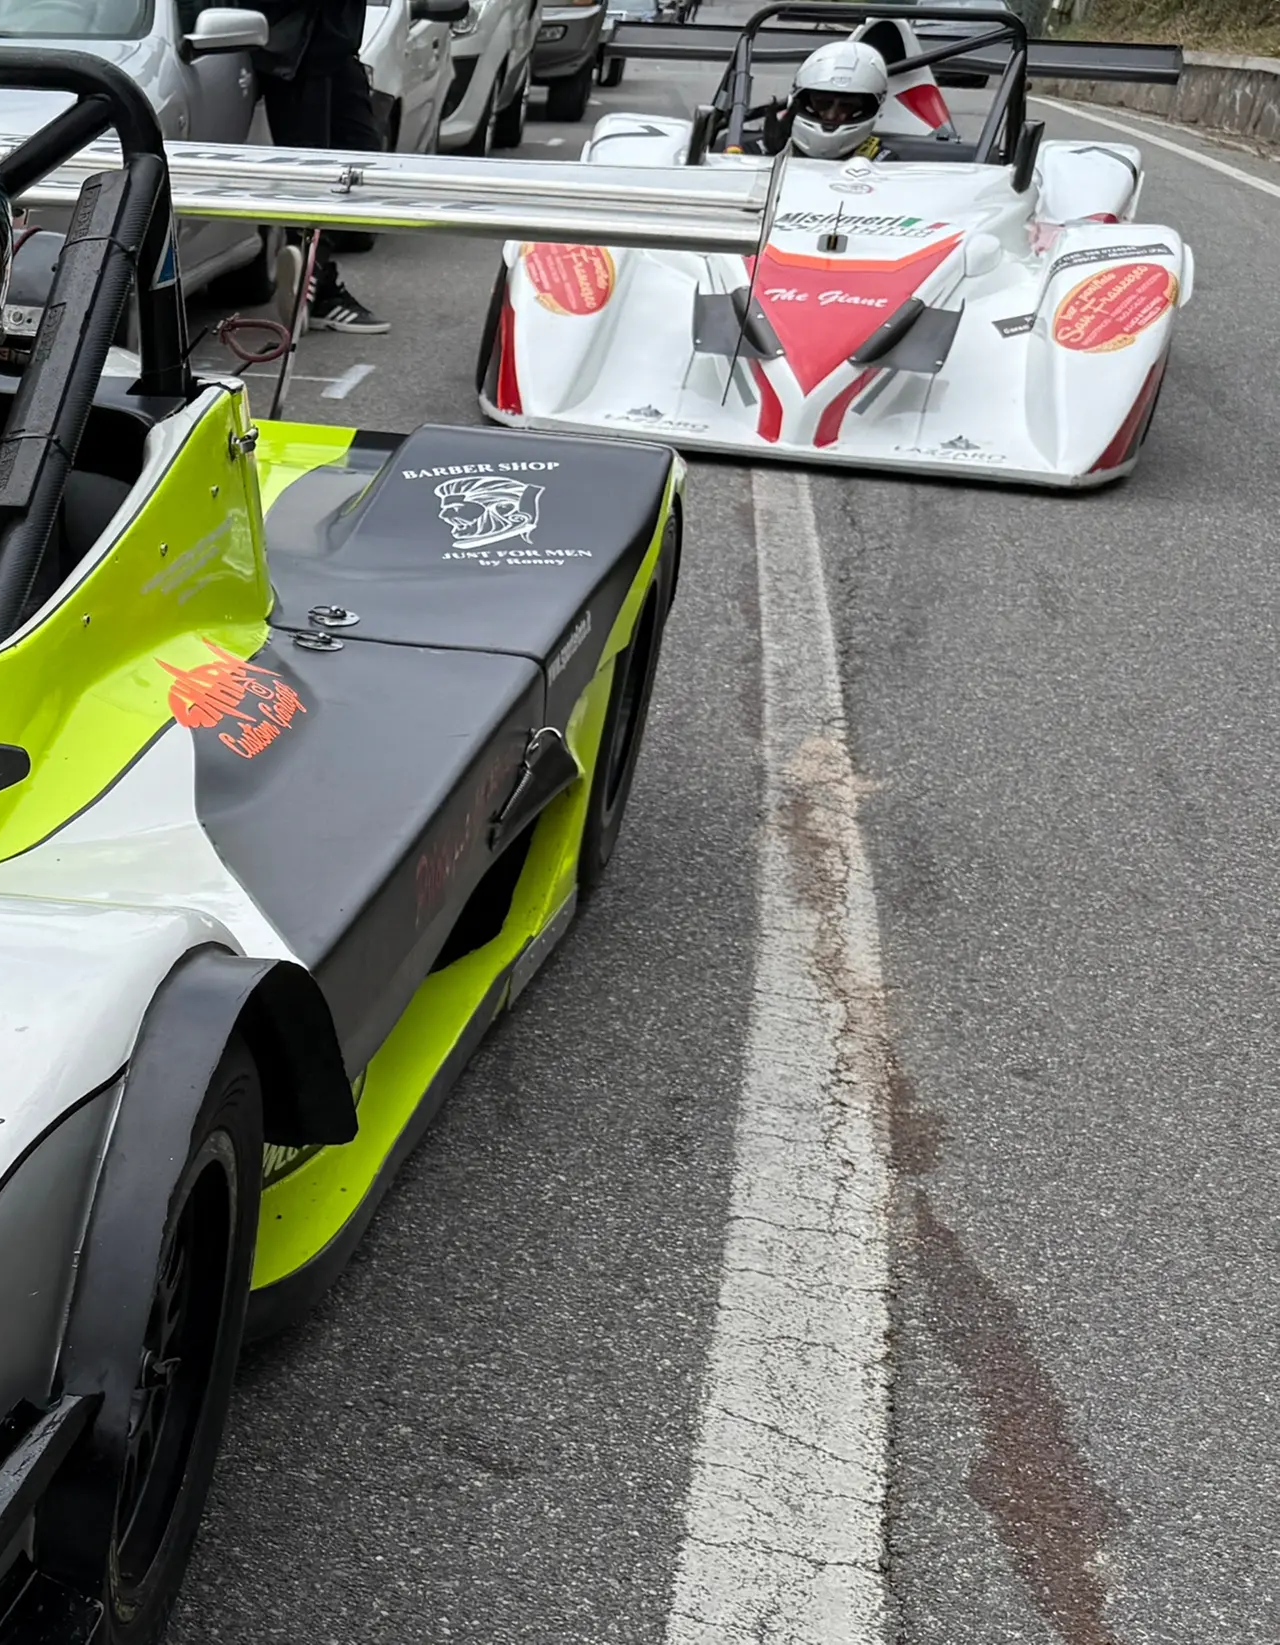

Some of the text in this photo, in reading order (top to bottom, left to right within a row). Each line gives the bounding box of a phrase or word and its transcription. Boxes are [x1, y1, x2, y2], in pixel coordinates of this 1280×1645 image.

[764, 287, 888, 308] The Giant
[401, 461, 560, 480] BARBER SHOP
[441, 549, 592, 560] JUST FOR MEN
[478, 559, 500, 567] by
